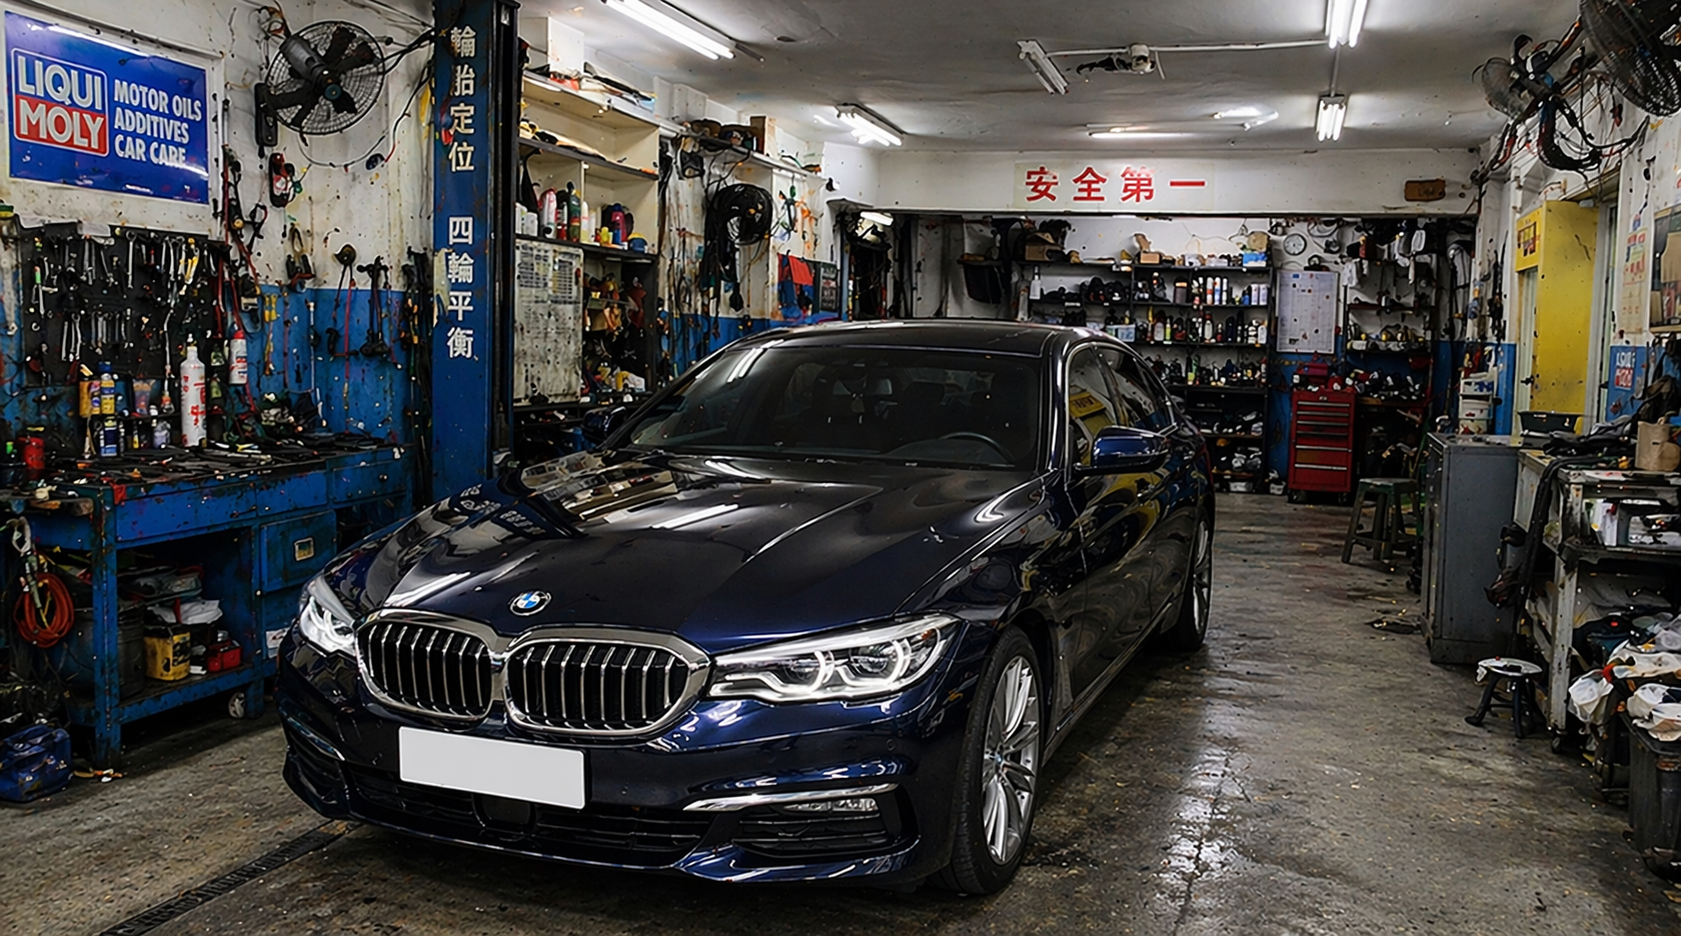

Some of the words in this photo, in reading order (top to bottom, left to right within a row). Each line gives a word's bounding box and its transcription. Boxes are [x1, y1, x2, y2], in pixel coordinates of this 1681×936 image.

[18, 55, 102, 110] LIQUI
[114, 79, 169, 114] MOTOR
[172, 95, 202, 121] OILS
[448, 25, 476, 172] 輪胎定位
[19, 98, 104, 149] MOLY
[114, 107, 190, 144] ADDITIVES
[114, 134, 147, 162] CAR
[150, 141, 186, 168] CARE
[1025, 166, 1205, 202] 安全第一
[447, 216, 474, 359] 四輪平衡
